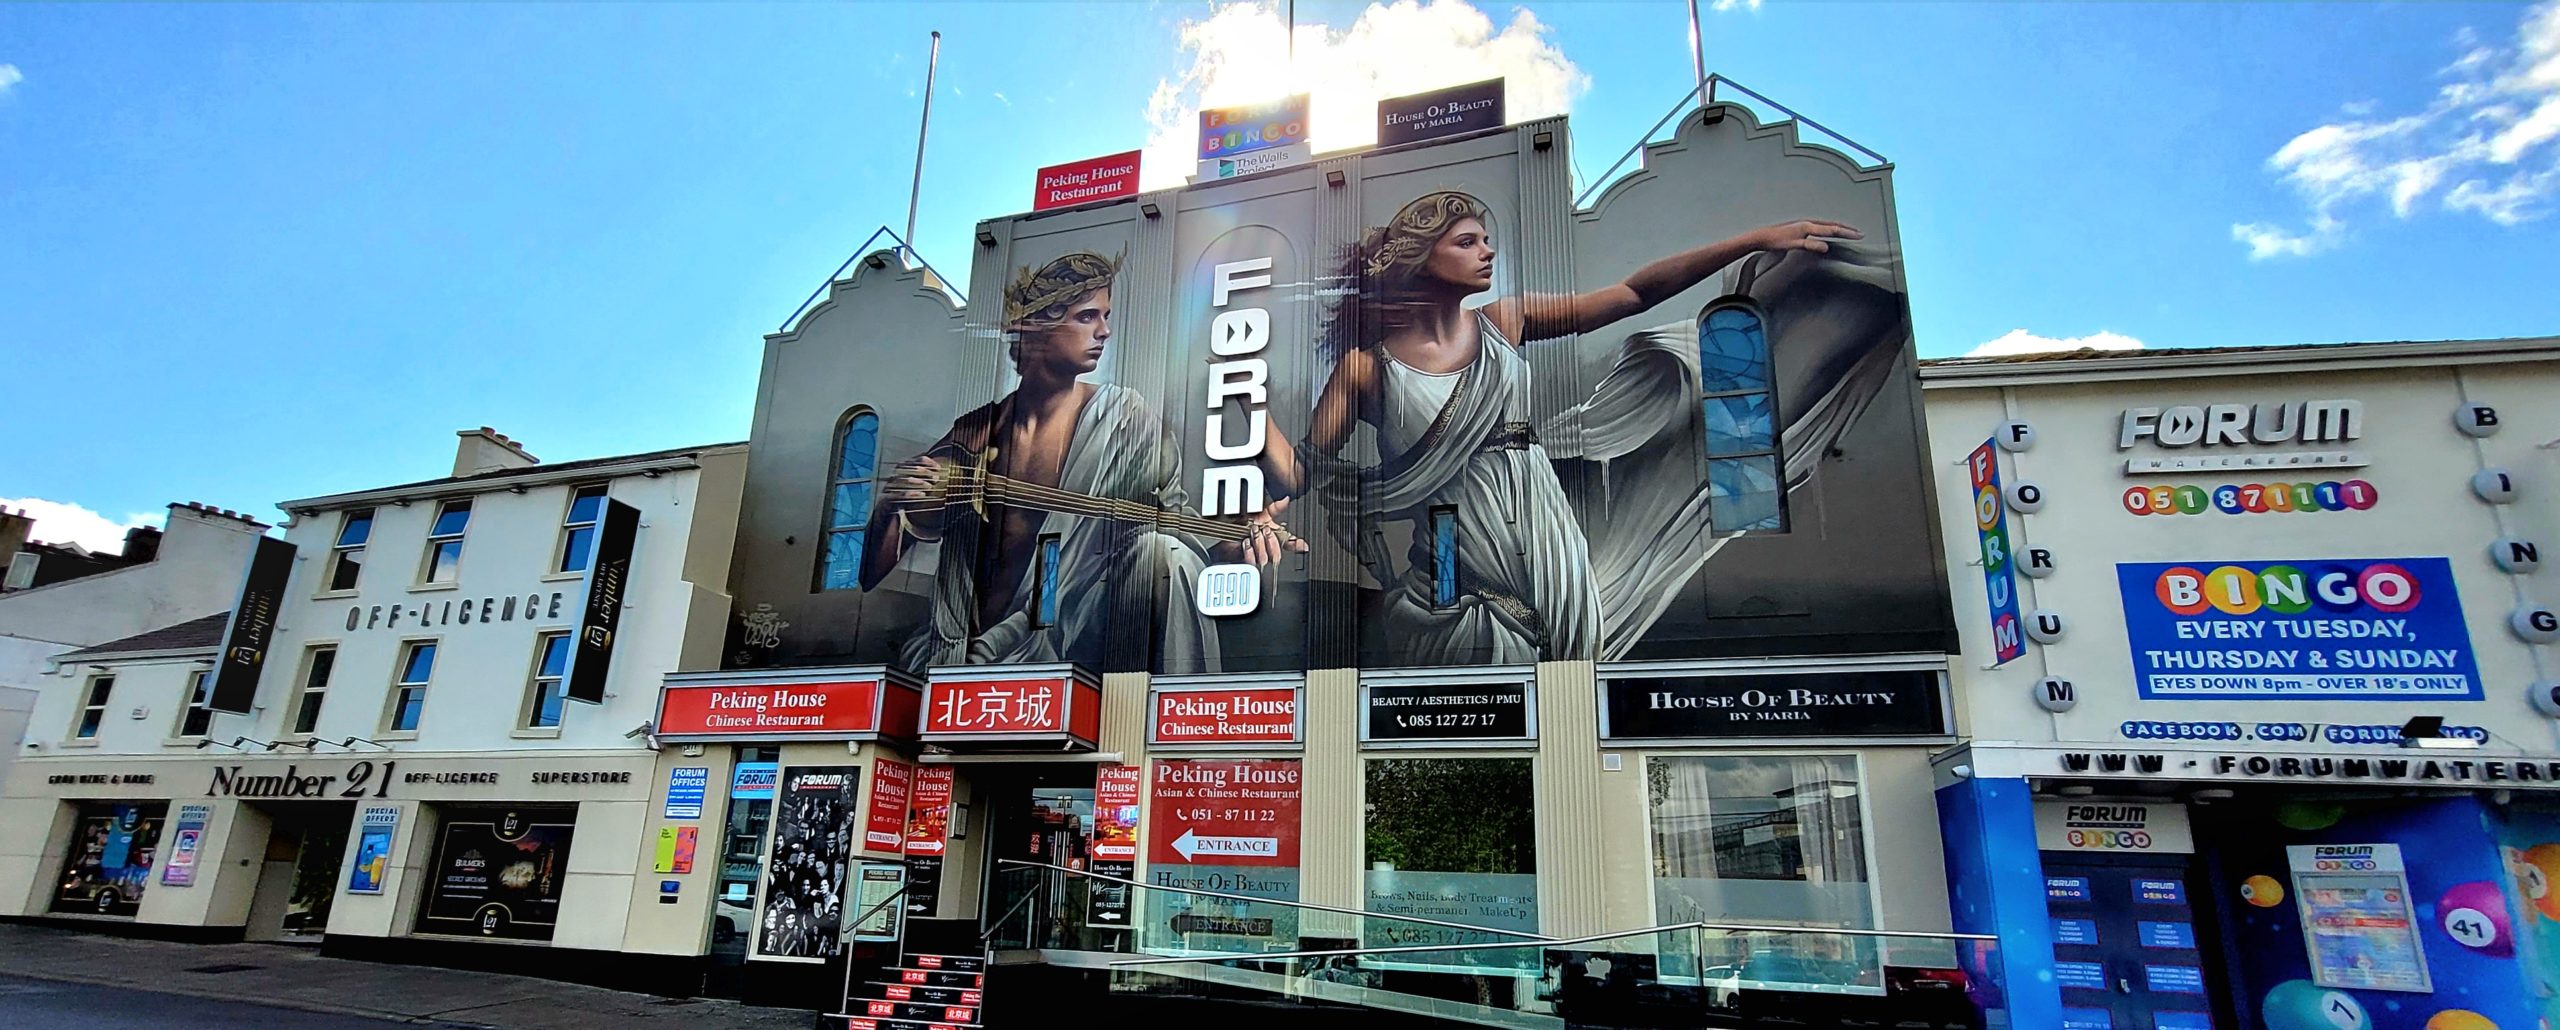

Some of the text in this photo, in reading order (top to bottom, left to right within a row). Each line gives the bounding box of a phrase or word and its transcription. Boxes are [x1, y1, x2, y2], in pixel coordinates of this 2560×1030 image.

[1413, 115, 1463, 130] BY MARIA
[1207, 121, 1301, 151] BINGO
[1236, 152, 1289, 168] The Walls
[1043, 164, 1133, 189] Peking House
[1050, 180, 1123, 202] Restaurant
[1202, 257, 1272, 516] FORUM
[2119, 400, 2362, 449] FORUM
[2126, 483, 2371, 512] 051 871111
[1975, 451, 2019, 653] FORUM
[2007, 422, 2075, 704] FORUM
[1205, 572, 1251, 608] 1990
[2163, 569, 2414, 609] BINGO
[345, 592, 563, 632] OFF-LICENCE
[2176, 619, 2416, 642] EVERY TUESDAY,
[2146, 650, 2458, 669] THURSDAY & SUNDAY
[2153, 677, 2196, 690] EYES
[2202, 677, 2258, 690] DOWN
[2263, 678, 2301, 693] 8pm
[2316, 677, 2367, 690] OVER
[2373, 677, 2409, 690] 18's
[2416, 677, 2463, 690] ONLY
[709, 690, 827, 713] Peking House
[937, 685, 1052, 728] 北京城
[1372, 696, 1414, 706] BEAUTY
[1421, 695, 1488, 705] AESTHETICS
[1496, 694, 1521, 704] PMU
[1648, 688, 1896, 710] HOUSE OF BEAUTY
[1162, 696, 1295, 720] Peking House
[1729, 711, 1811, 721] BY MARIA
[706, 713, 825, 727] Chinese Restaurant
[1161, 721, 1294, 735] Chinese Restaurant
[1409, 713, 1496, 727] 085 127 27 17
[205, 760, 632, 798] Number 21 OFF-LICENCE SUPERSTORE
[675, 768, 706, 777] FORUM
[735, 774, 776, 785] FORUM
[800, 774, 843, 785] FORUM
[876, 760, 909, 784] Peking
[917, 768, 951, 781] Peking
[1100, 767, 1138, 781] Peking
[1157, 765, 1298, 788] Peking House
[671, 777, 706, 786] OFFICES
[876, 778, 906, 797] House
[917, 780, 949, 791] House
[1101, 781, 1136, 792] House
[1155, 787, 1299, 799] Asian & Chinese Restaurant
[365, 807, 398, 815] SPECIAL
[1191, 808, 1212, 821] 051
[1224, 809, 1240, 821] 87
[1243, 809, 1255, 821] 11
[1260, 809, 1275, 821] 22
[2066, 805, 2147, 822] FORUM
[869, 833, 895, 842] ENTRANCE
[1197, 839, 1271, 852] ENTRANCE
[2068, 831, 2150, 847] BINGO
[2315, 845, 2373, 856] FORUM
[2047, 879, 2080, 887] FORUM
[2141, 881, 2175, 890] FORUM
[1376, 902, 1385, 913] &
[1479, 906, 1527, 919] MakeUp
[1196, 919, 1266, 933] ENTRANCE
